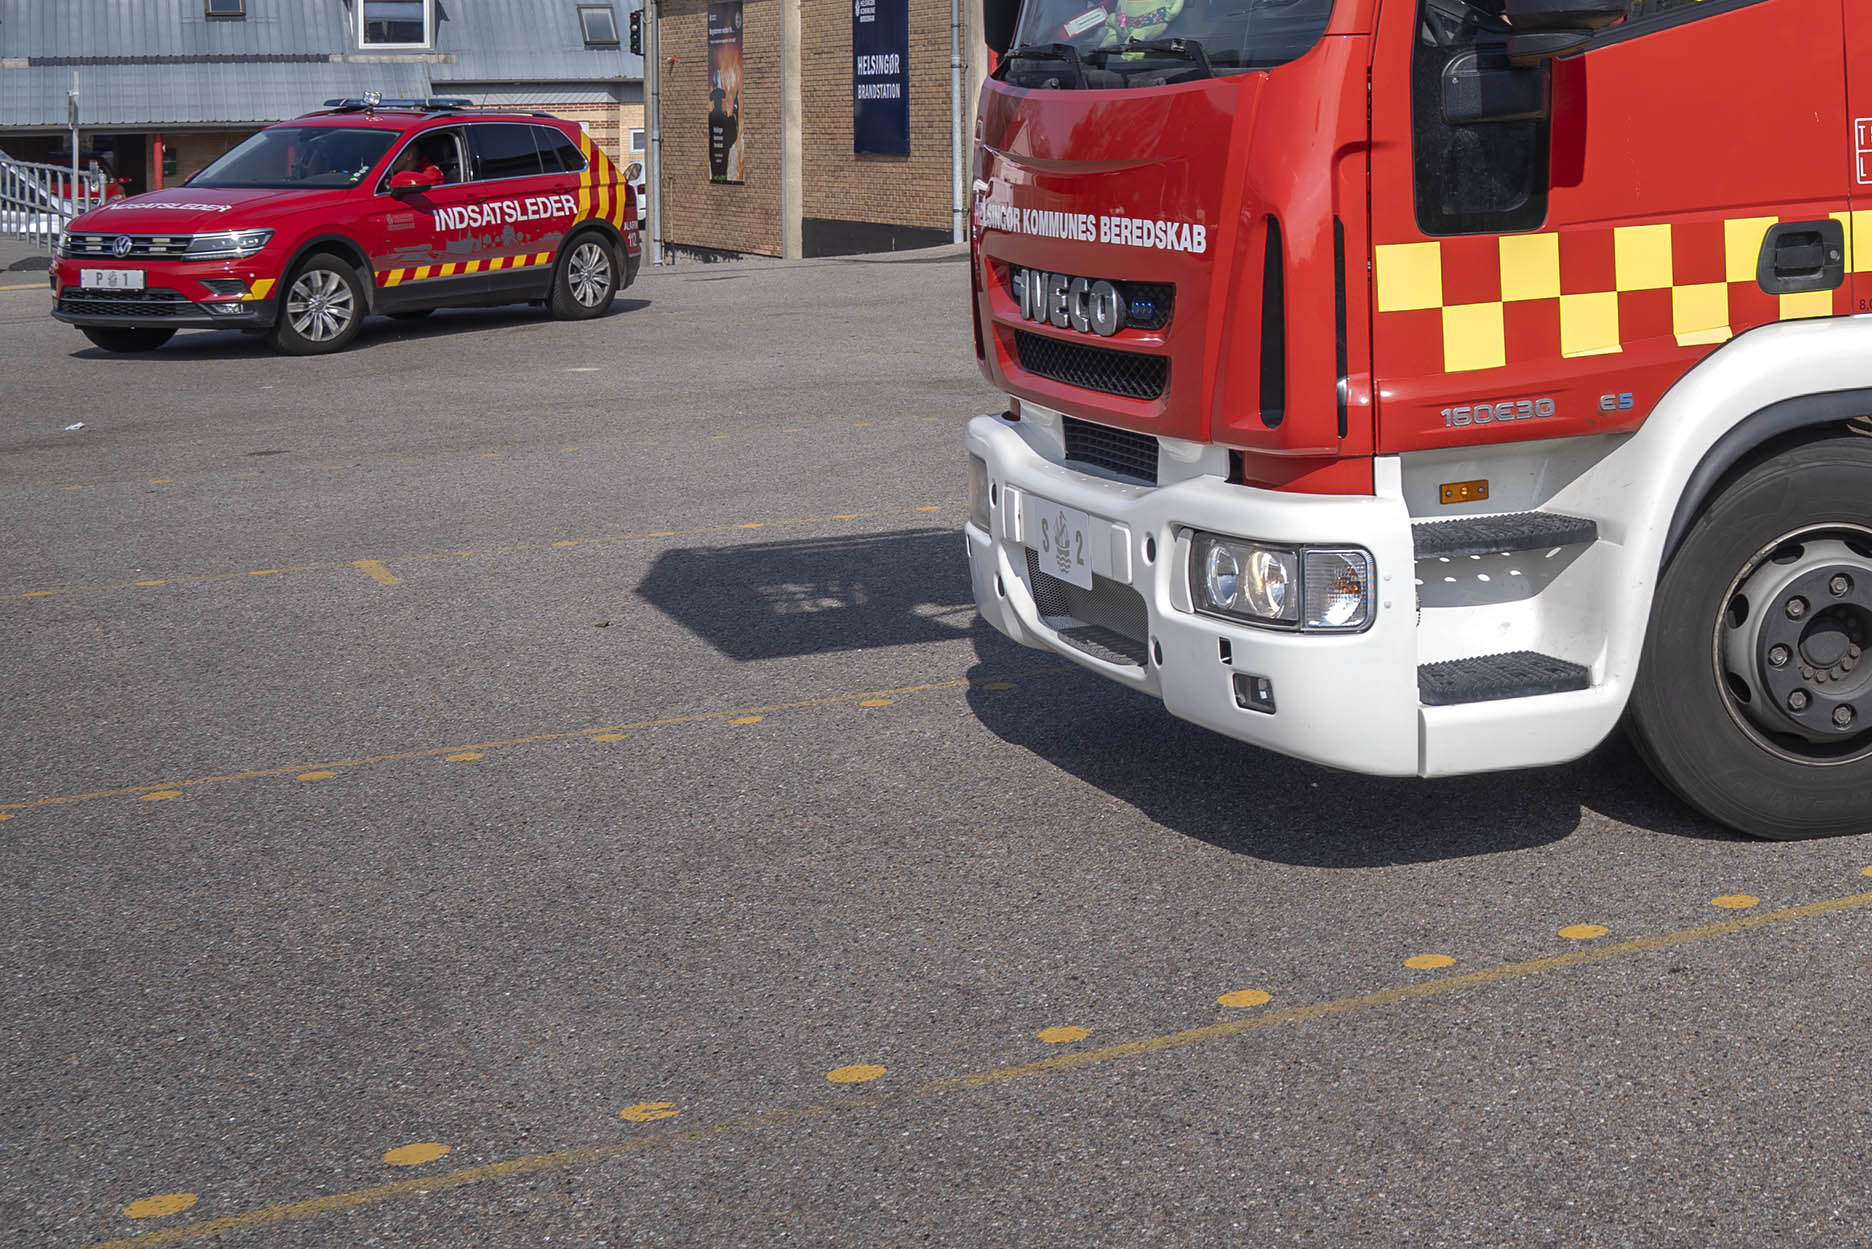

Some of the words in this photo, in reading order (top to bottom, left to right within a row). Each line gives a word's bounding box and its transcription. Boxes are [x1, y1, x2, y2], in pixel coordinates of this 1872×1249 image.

[857, 53, 900, 76] HELSINGØR
[857, 82, 901, 100] BRANDSTATION
[1858, 124, 1866, 146] T
[1860, 156, 1868, 177] L
[432, 194, 578, 232] INDSATSLEDER
[1022, 208, 1097, 242] KOMMUNES
[1099, 215, 1207, 254] BEREDSKAB
[1016, 267, 1123, 337] IVECO
[1440, 398, 1555, 428] 160E30
[1599, 392, 1634, 411] E5
[1041, 517, 1050, 553] S
[1075, 530, 1085, 566] 2
